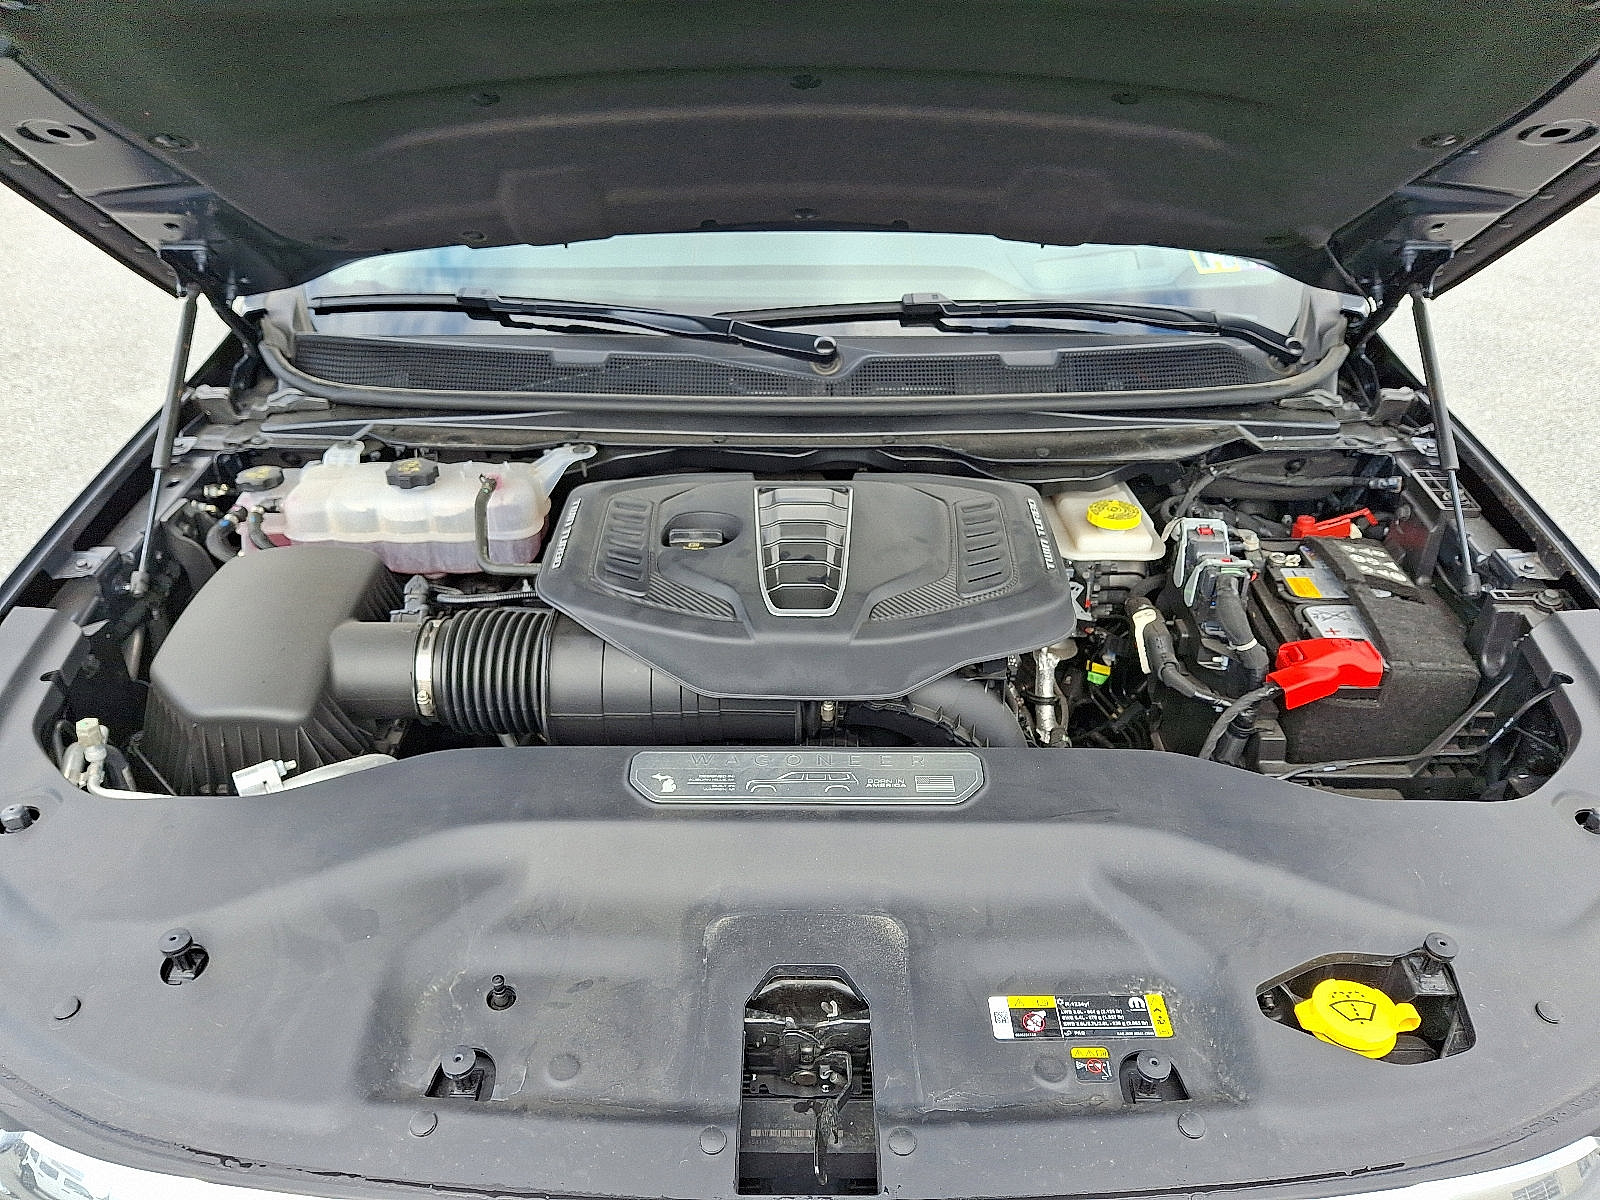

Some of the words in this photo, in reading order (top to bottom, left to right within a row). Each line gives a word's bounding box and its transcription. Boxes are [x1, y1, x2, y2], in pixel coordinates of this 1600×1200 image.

[1027, 498, 1046, 537] TURBO
[552, 525, 572, 569] TURBO
[1040, 538, 1056, 570] TWIN
[690, 754, 926, 766] WAGONEER
